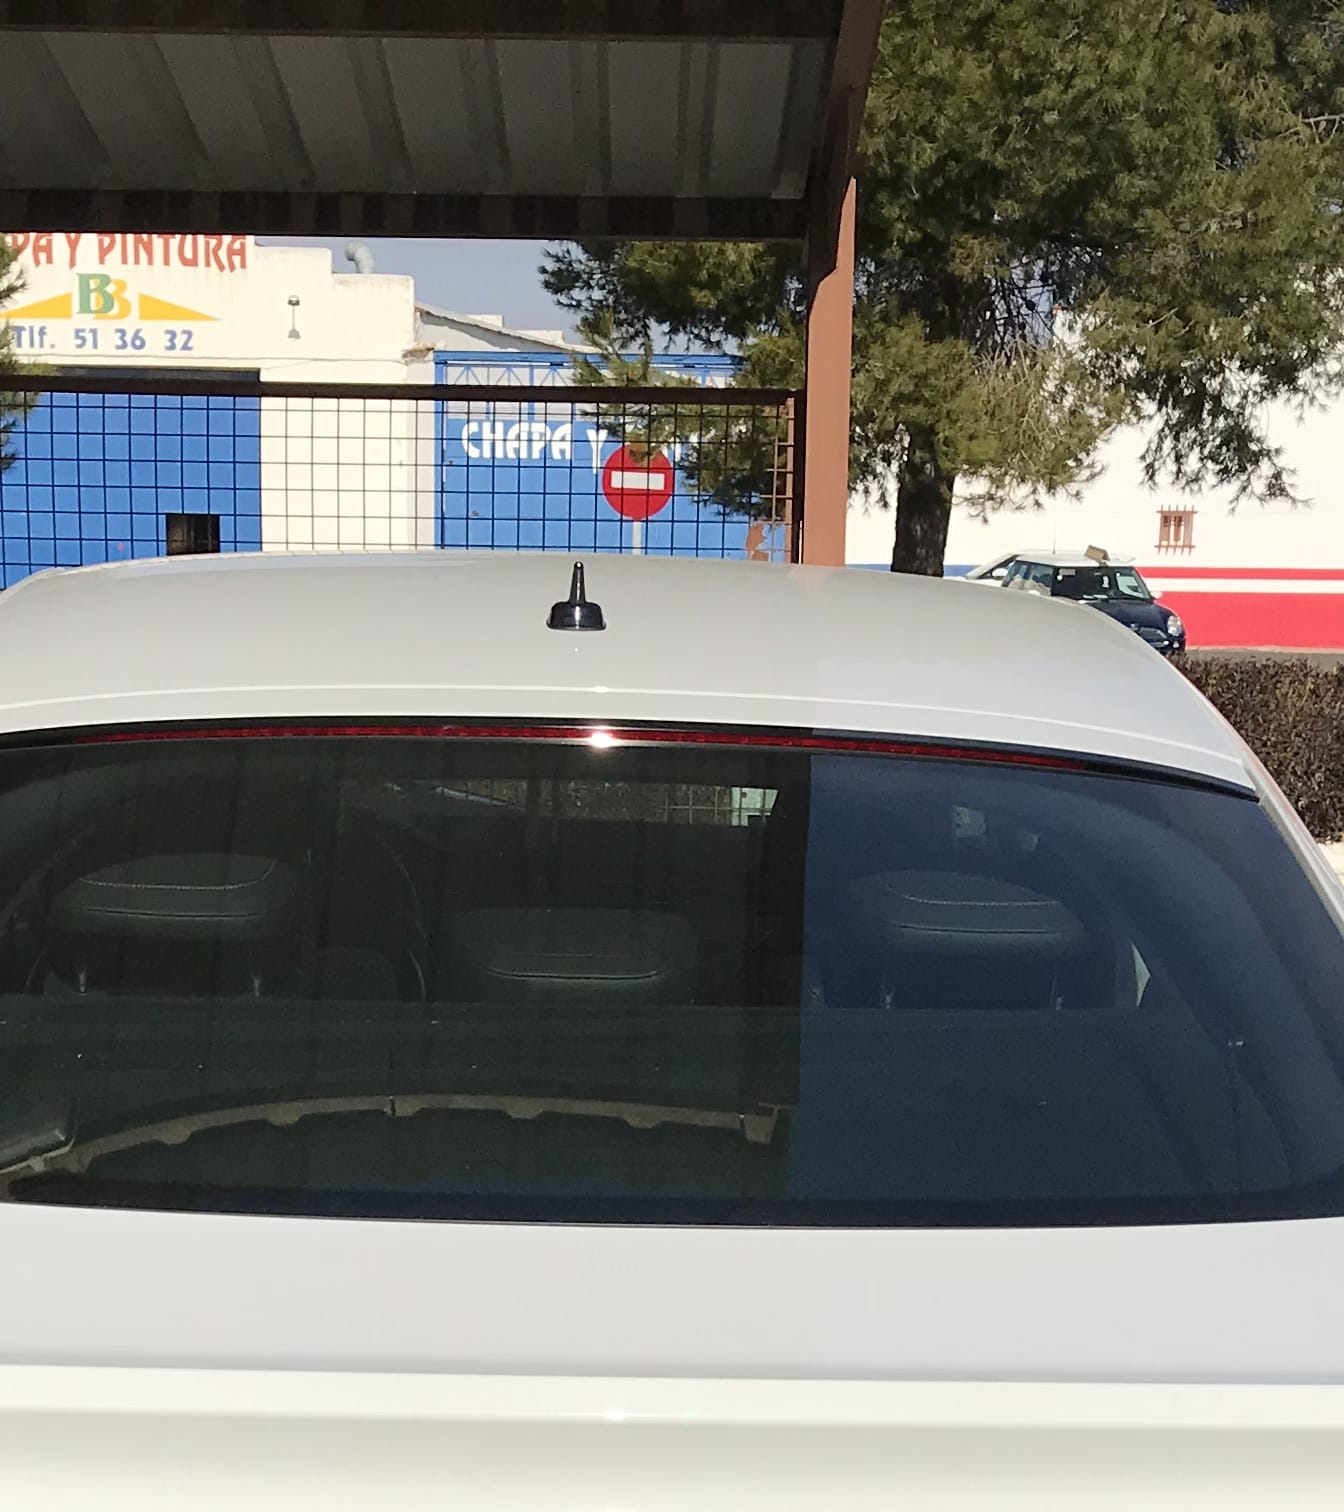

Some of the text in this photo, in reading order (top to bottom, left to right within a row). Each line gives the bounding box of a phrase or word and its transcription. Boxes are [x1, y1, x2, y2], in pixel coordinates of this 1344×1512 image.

[64, 233, 82, 269] Y
[96, 233, 247, 273] PINTURA
[13, 326, 194, 351] Tlf. 51 36 32
[461, 421, 572, 460] CHAPA
[586, 429, 609, 475] Y
